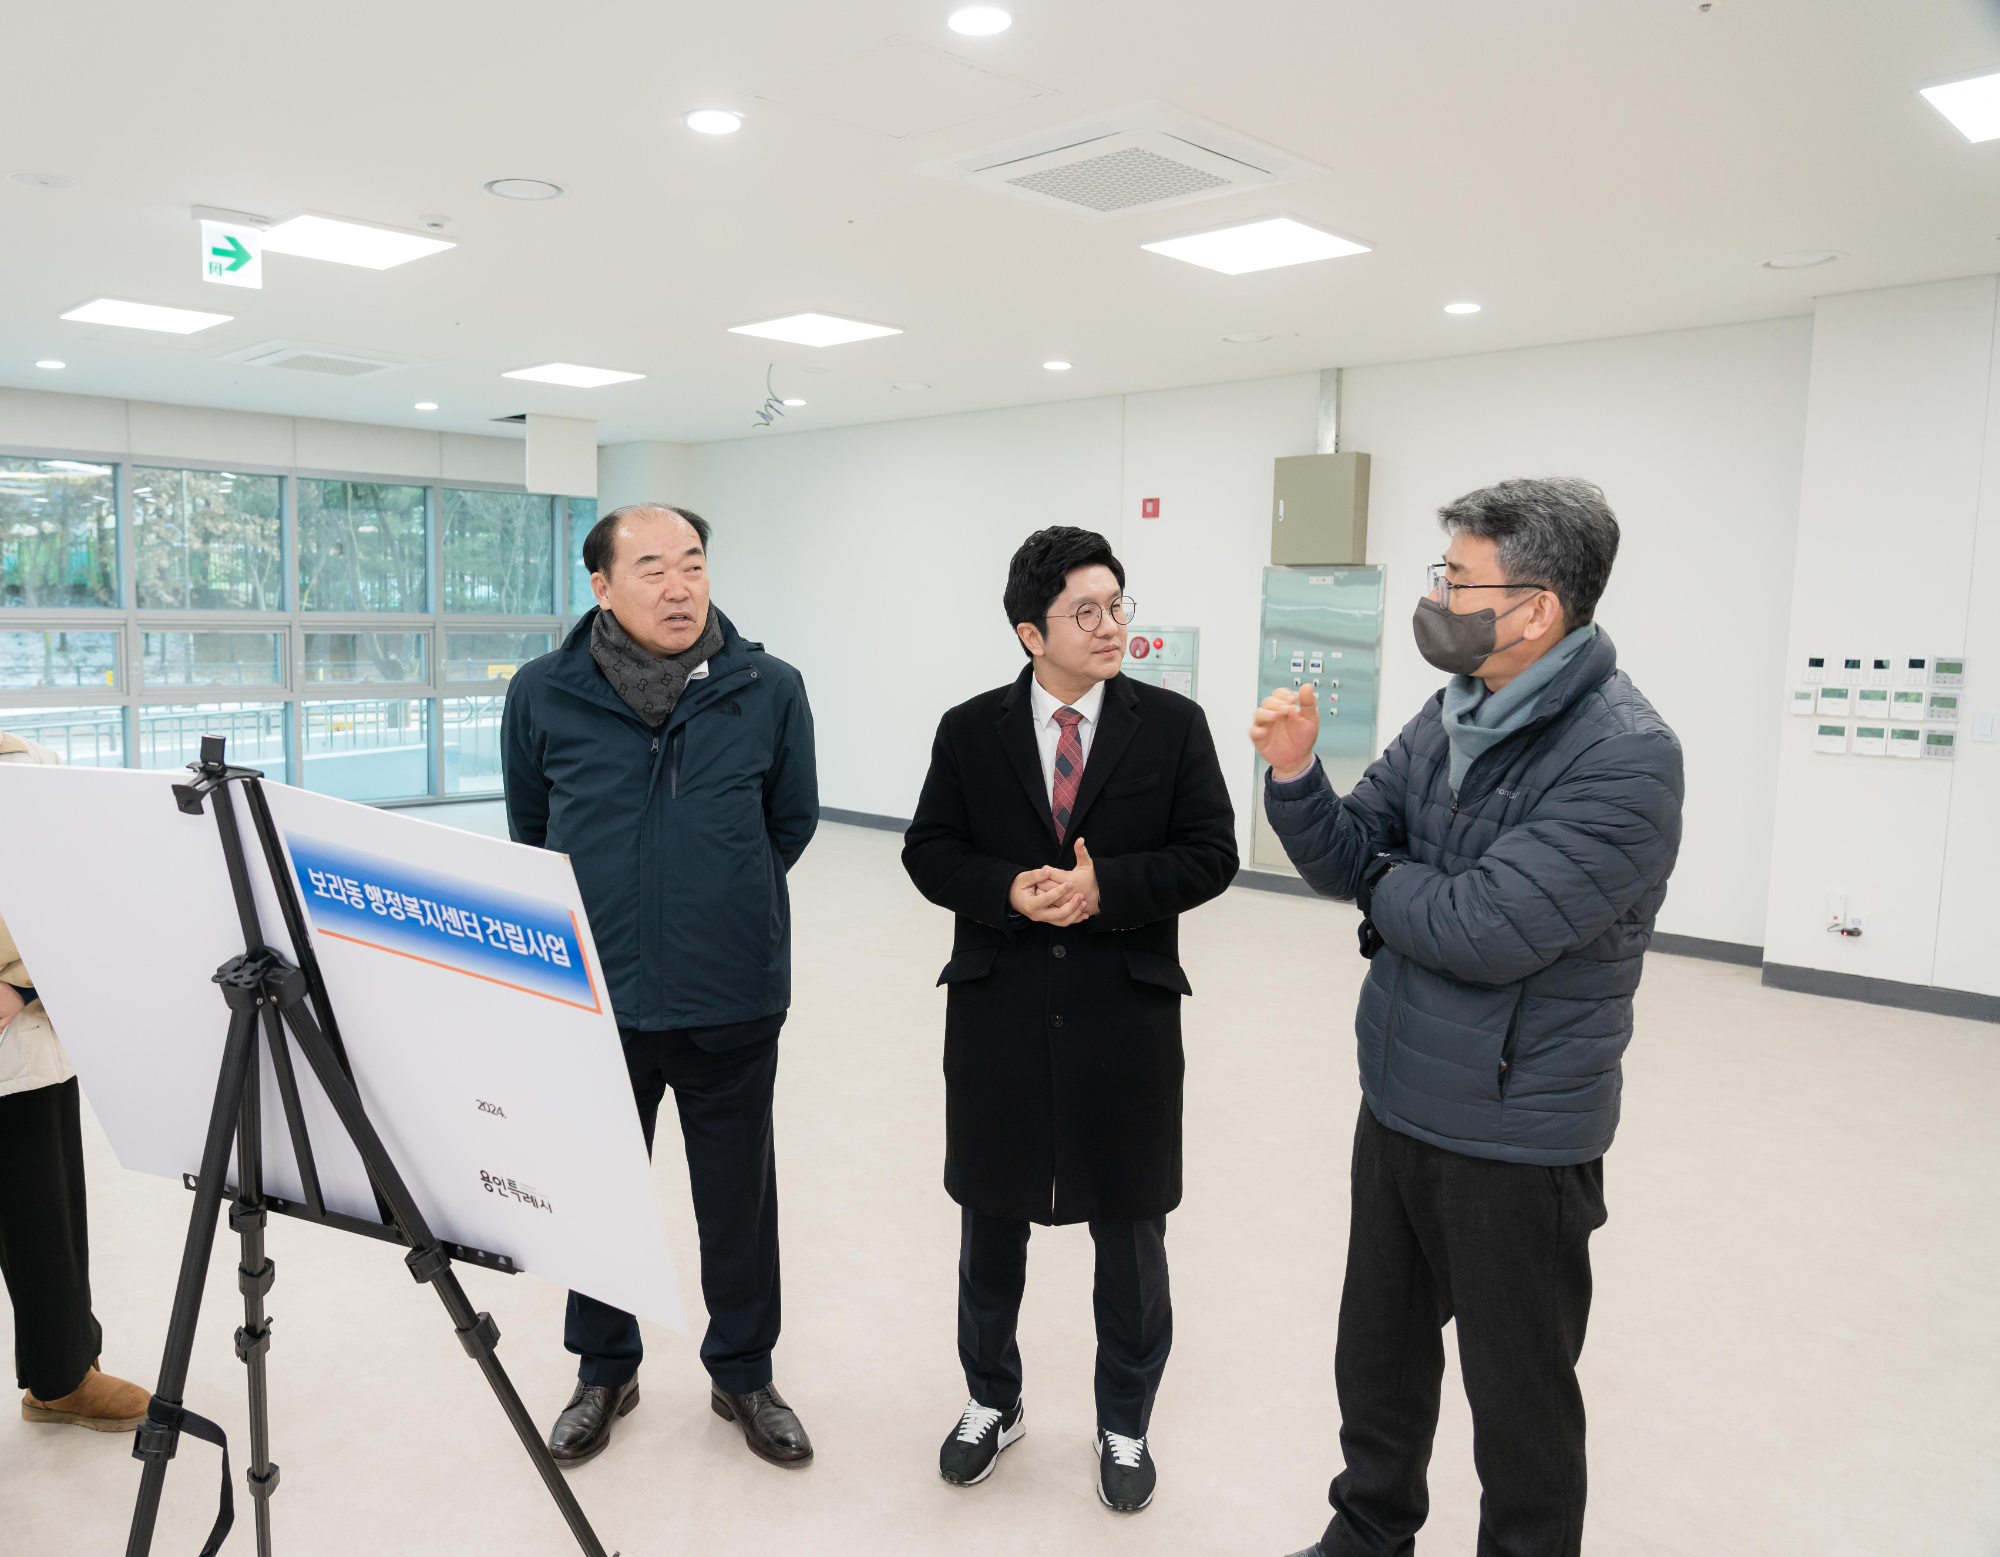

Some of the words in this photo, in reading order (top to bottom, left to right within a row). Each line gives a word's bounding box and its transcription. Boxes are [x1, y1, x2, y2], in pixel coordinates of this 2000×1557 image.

[307, 867, 366, 910] 보라동
[366, 883, 484, 944] 행정복지센터
[481, 916, 571, 968] 건립사업
[476, 1099, 507, 1118] 2024.
[480, 1169, 553, 1213] 용인특례시
